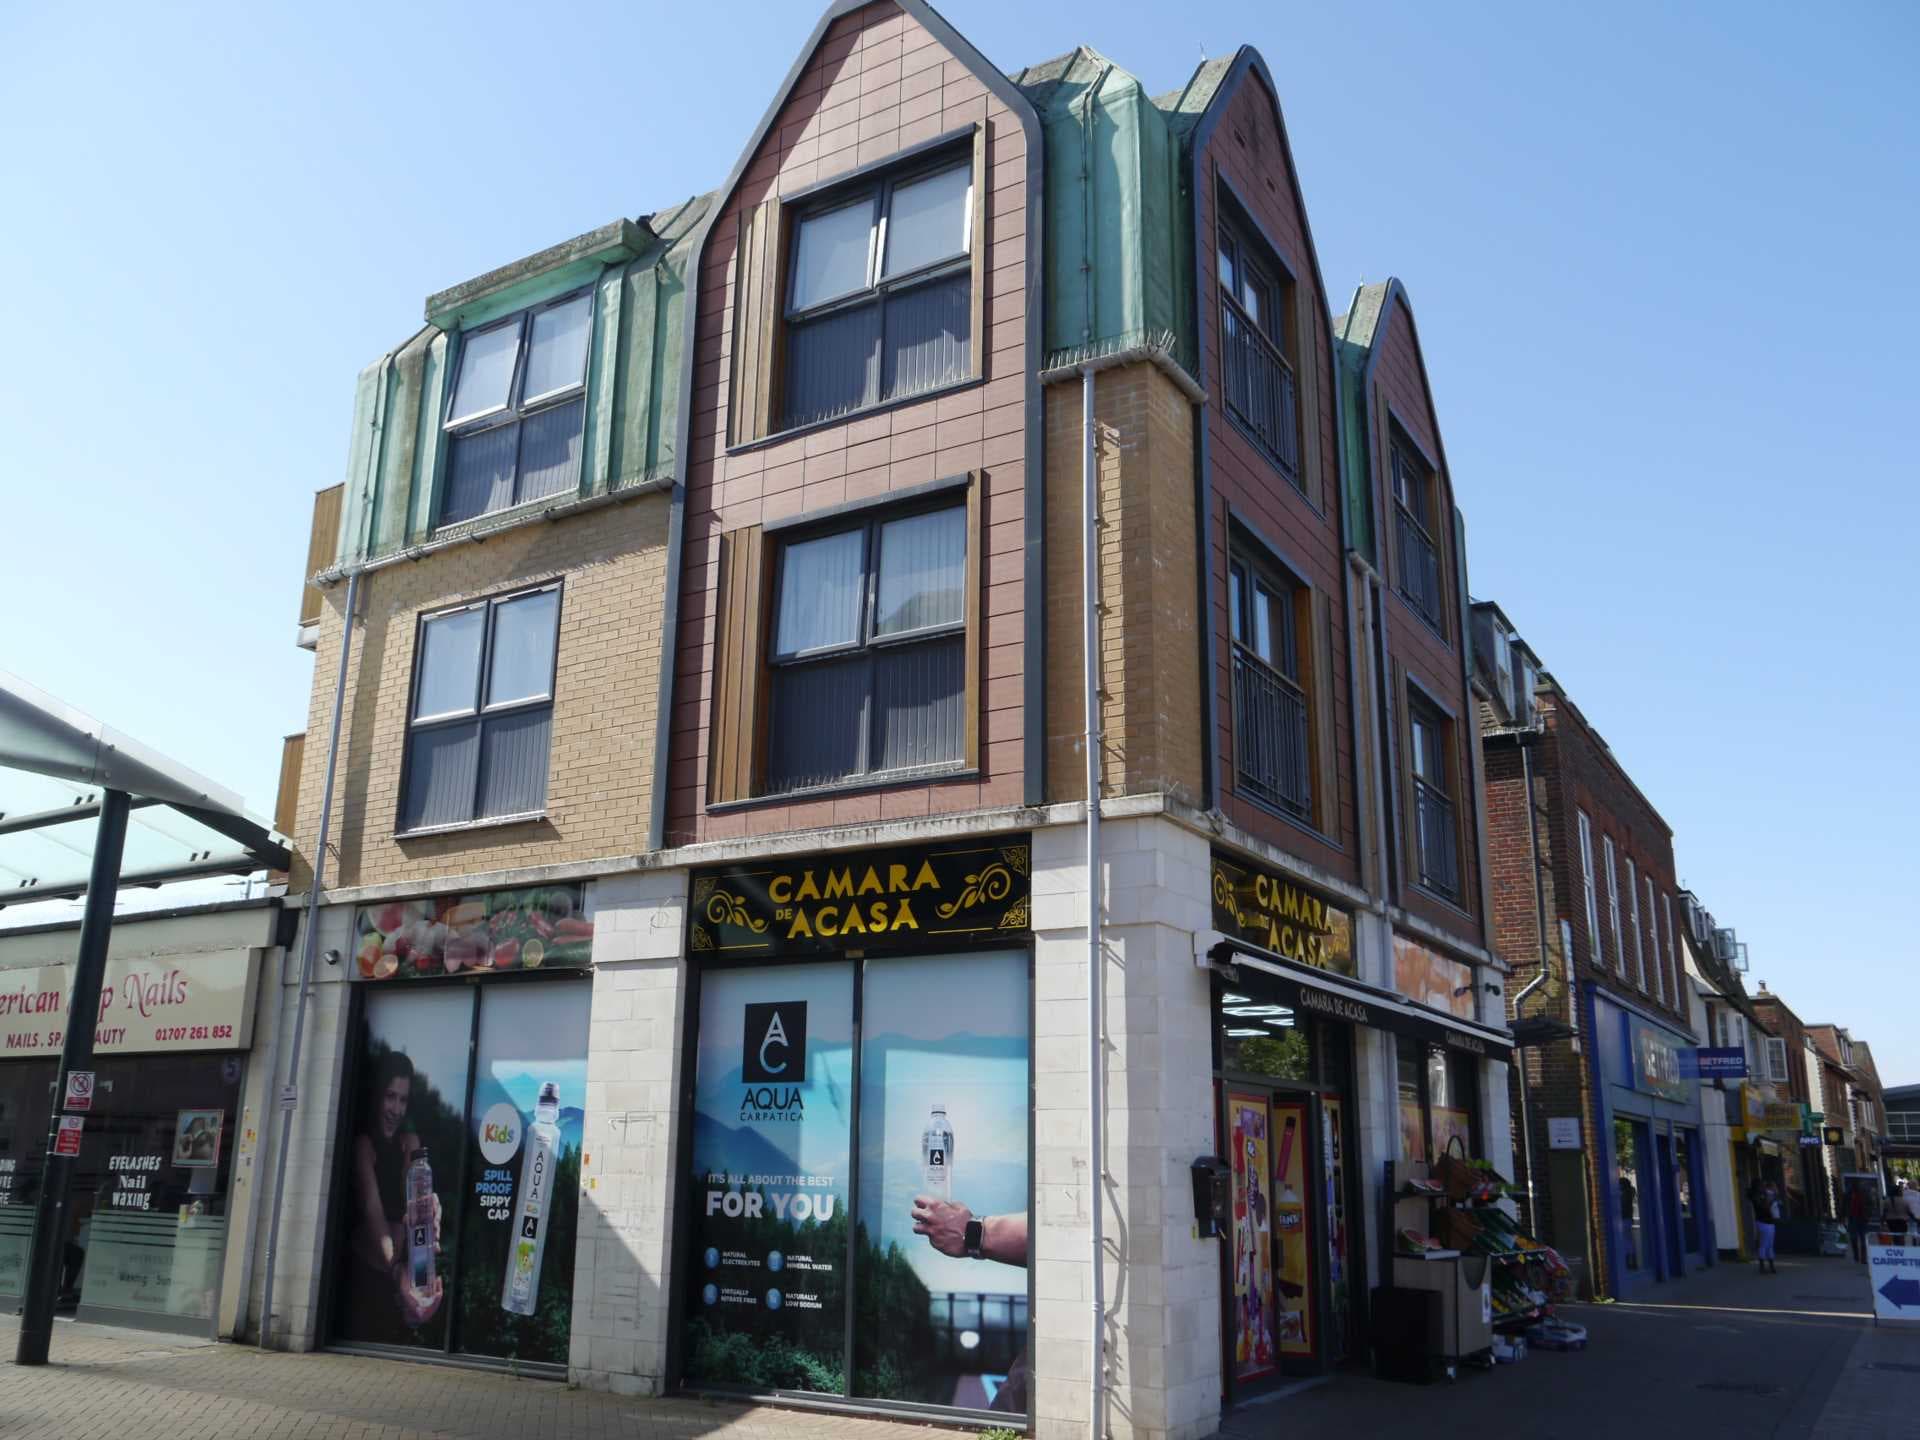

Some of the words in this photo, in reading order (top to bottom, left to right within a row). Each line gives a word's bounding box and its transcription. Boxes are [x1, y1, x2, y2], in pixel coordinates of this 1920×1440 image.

[775, 908, 793, 921] DE
[123, 969, 188, 1018] Nails
[155, 1027, 187, 1041] 01707
[190, 1026, 209, 1040] 261
[212, 1024, 233, 1038] 852
[1699, 1056, 1744, 1065] BETFRED
[740, 1087, 804, 1110] AQUA
[485, 1123, 514, 1144] Kids
[109, 1155, 162, 1171] EYELASHES
[484, 1169, 512, 1180] SPILL
[728, 1174, 746, 1185] ALL
[748, 1174, 784, 1186] ABOUT
[785, 1175, 806, 1187] THE
[807, 1176, 835, 1188] BEST
[119, 1175, 147, 1189] Nail
[476, 1182, 512, 1194] PROOF
[479, 1195, 511, 1208] SIPPY
[706, 1191, 763, 1218] FOR
[771, 1193, 834, 1221] YOU
[487, 1208, 510, 1221] CAP
[811, 1263, 833, 1271] WATER
[785, 1300, 799, 1308] LOW
